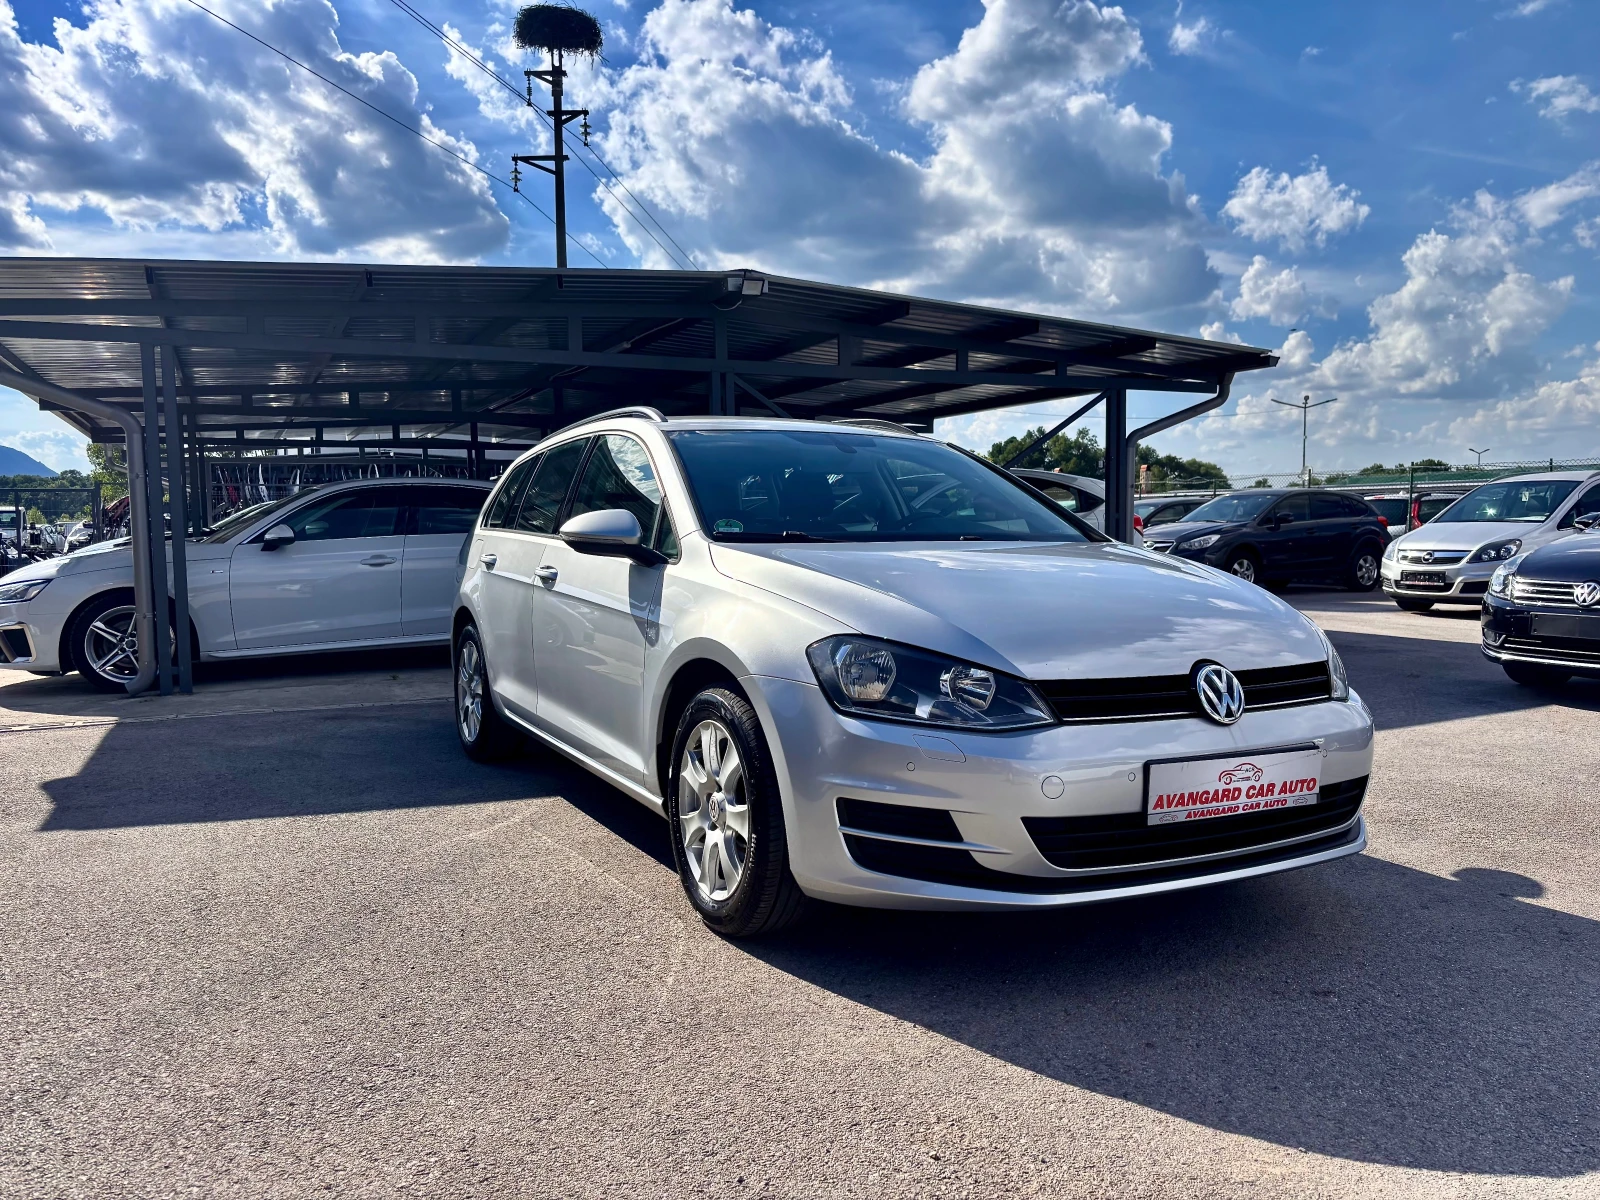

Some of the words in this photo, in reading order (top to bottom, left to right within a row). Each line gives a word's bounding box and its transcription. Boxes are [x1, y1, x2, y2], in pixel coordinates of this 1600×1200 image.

[1199, 666, 1243, 722] VW
[1152, 786, 1242, 810] AVANGARD
[1245, 783, 1276, 800] CAR
[1277, 777, 1317, 796] AUTO
[1185, 805, 1240, 819] AVANGARD
[1242, 802, 1262, 812] CAR
[1262, 799, 1288, 809] AUTO
